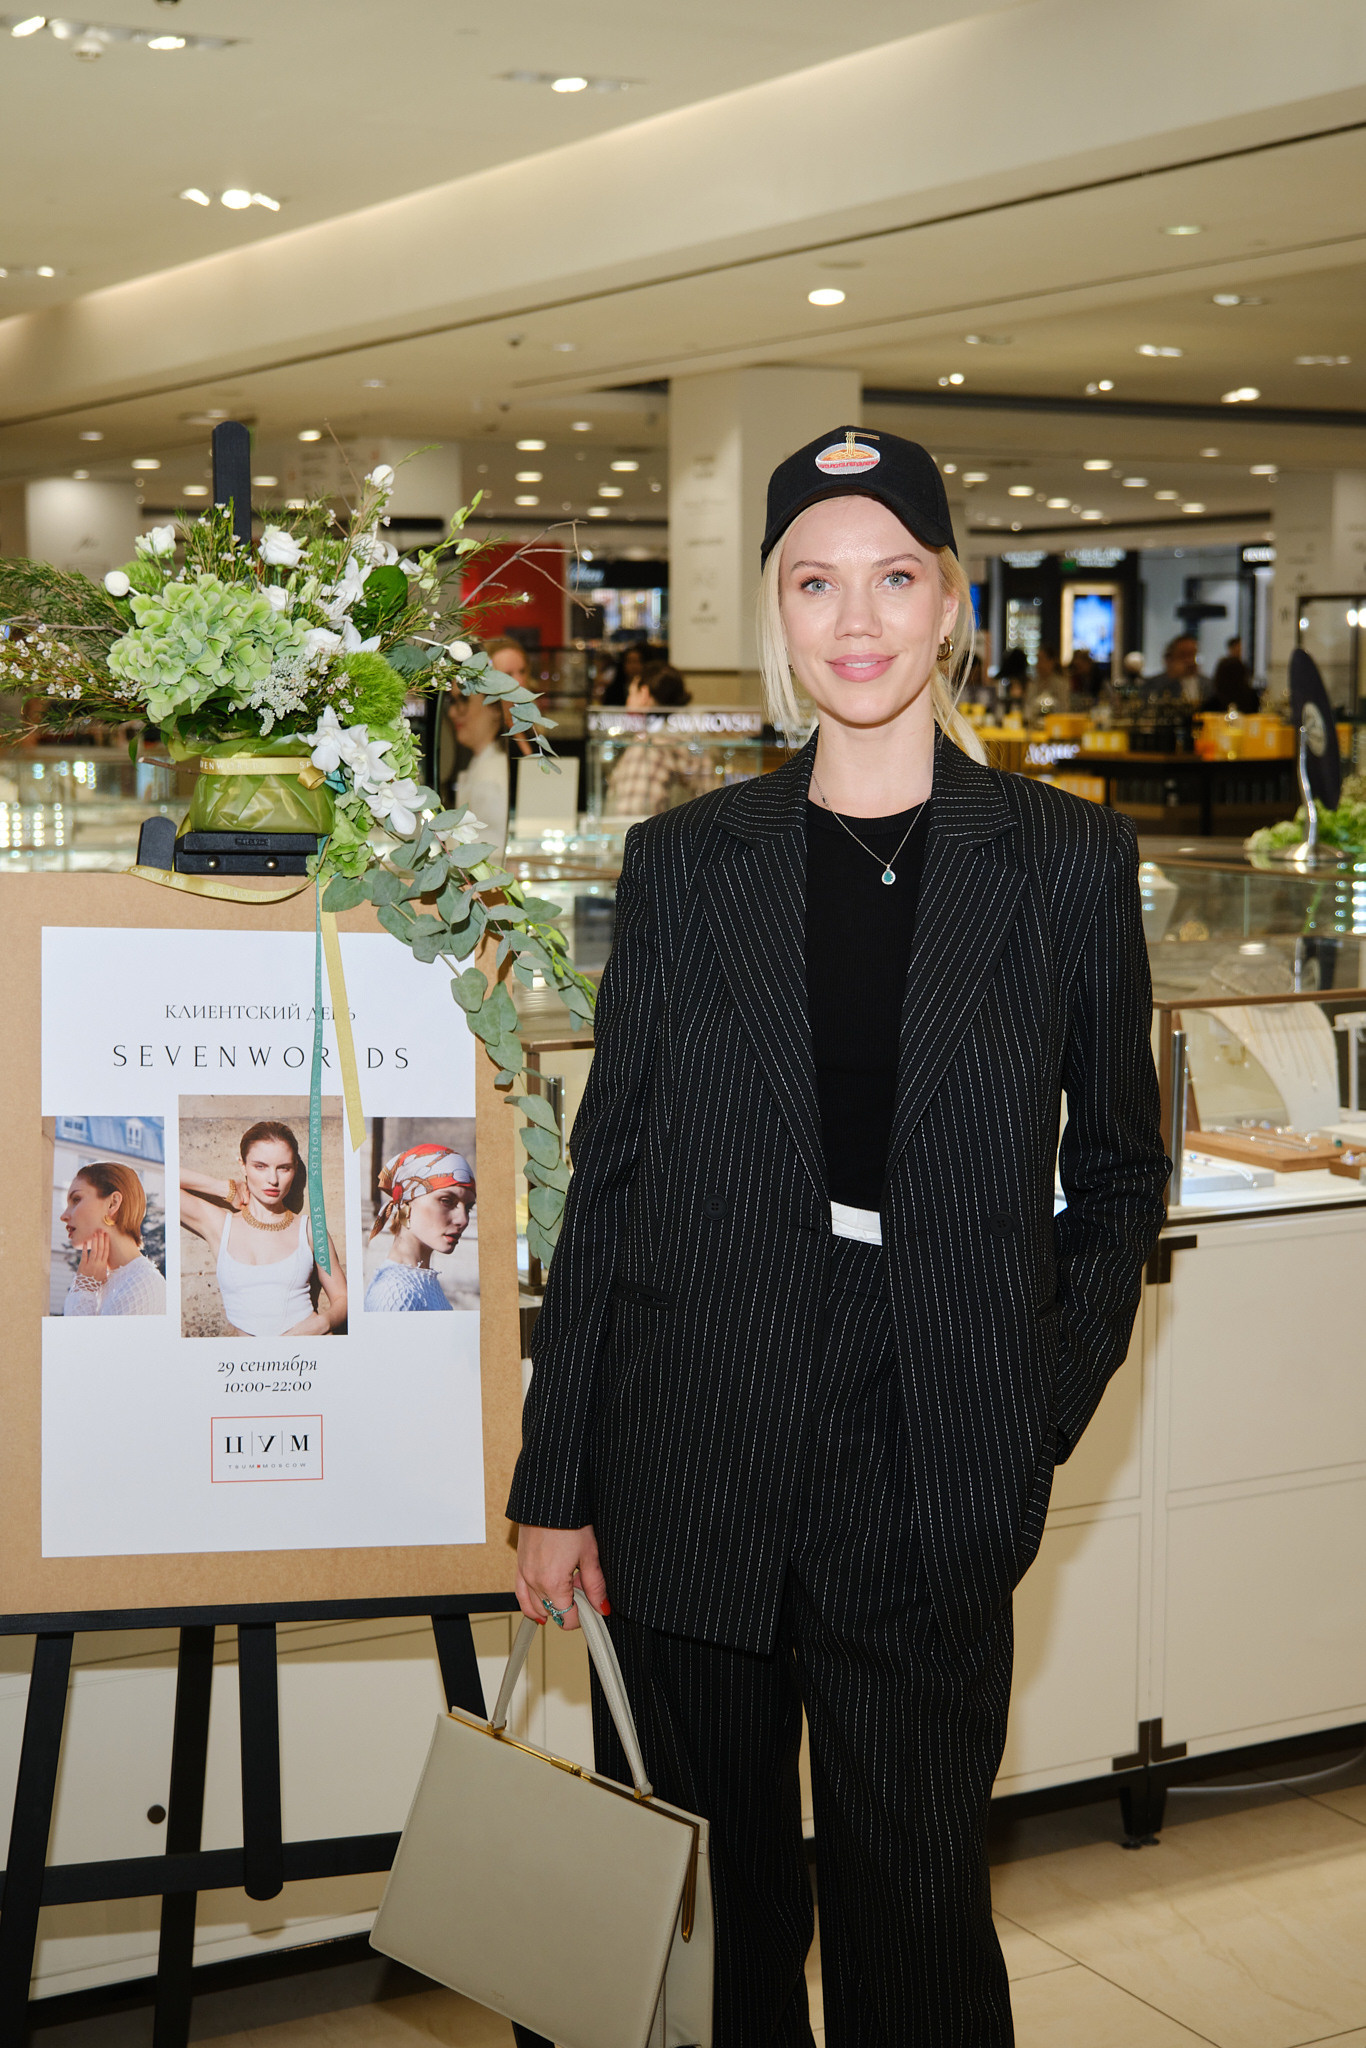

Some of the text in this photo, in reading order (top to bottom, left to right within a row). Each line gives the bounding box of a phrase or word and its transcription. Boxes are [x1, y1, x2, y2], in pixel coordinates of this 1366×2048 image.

[667, 712, 761, 733] SWAROVSKI
[165, 1002, 300, 1020] КЛИЕНТСКИЙ
[112, 1044, 409, 1069] SEVENWORDS
[311, 1086, 321, 1176] SEVENWORLDS
[217, 1354, 318, 1377] 29 сентября
[224, 1380, 312, 1393] 10:00-22:00
